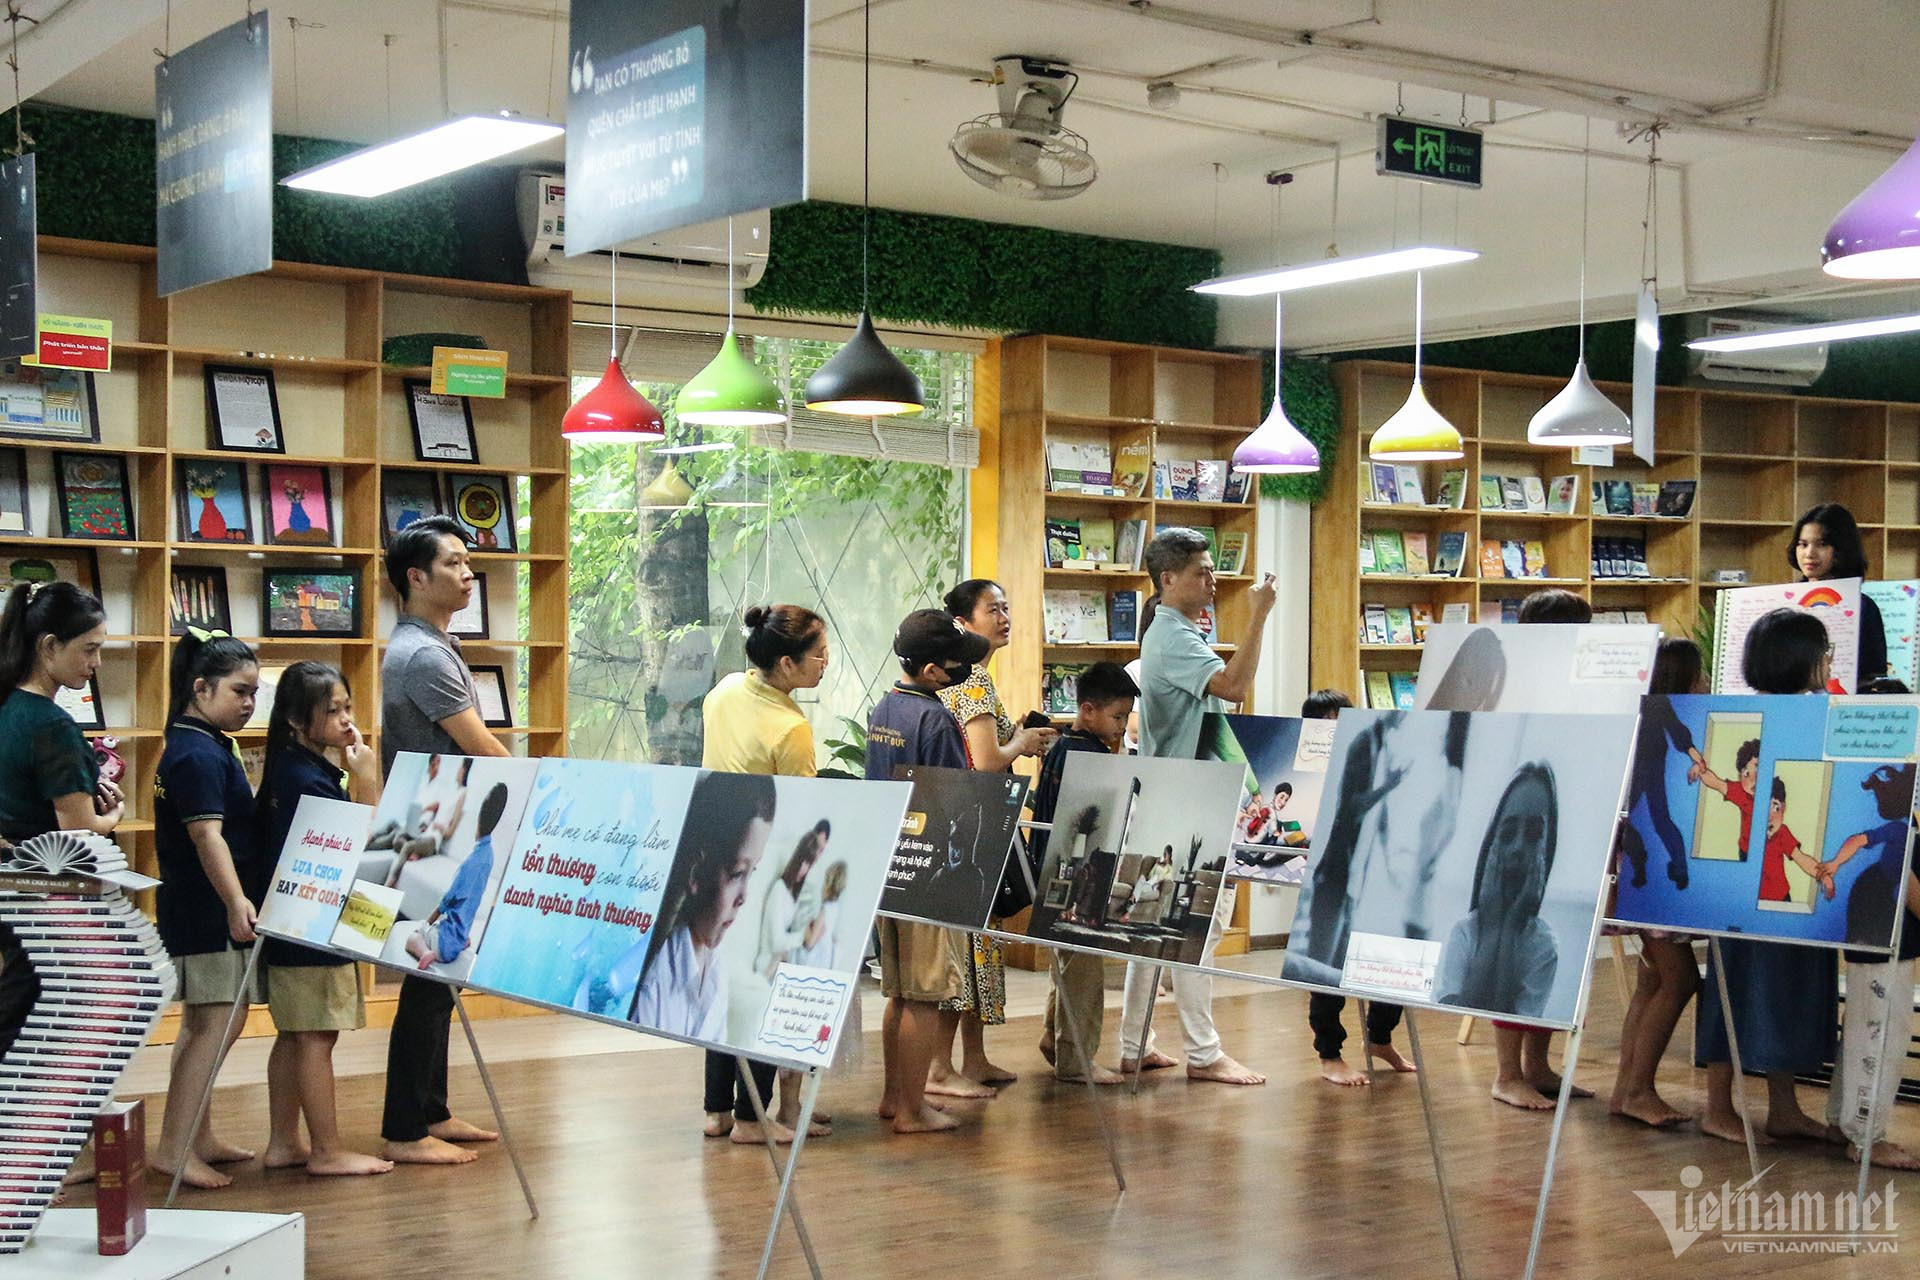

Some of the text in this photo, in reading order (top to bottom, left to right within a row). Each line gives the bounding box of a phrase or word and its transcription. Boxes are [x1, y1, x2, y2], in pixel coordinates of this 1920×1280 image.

[594, 74, 612, 98] BẠN
[614, 65, 629, 88] CÓ
[666, 84, 696, 115] HẠNH
[675, 122, 701, 149] TÌNH
[1449, 162, 1472, 174] EXIT
[301, 829, 353, 852] Hạnh phúc là
[536, 807, 672, 868] Cha mẹ có đang làm
[292, 859, 343, 884] LỰA CHỌN
[521, 843, 545, 874] tổn
[545, 852, 597, 886] thương
[596, 870, 622, 886] con
[275, 879, 298, 896] HAY
[297, 880, 318, 901] KẾT
[503, 885, 654, 935] danh nghĩa tình thương
